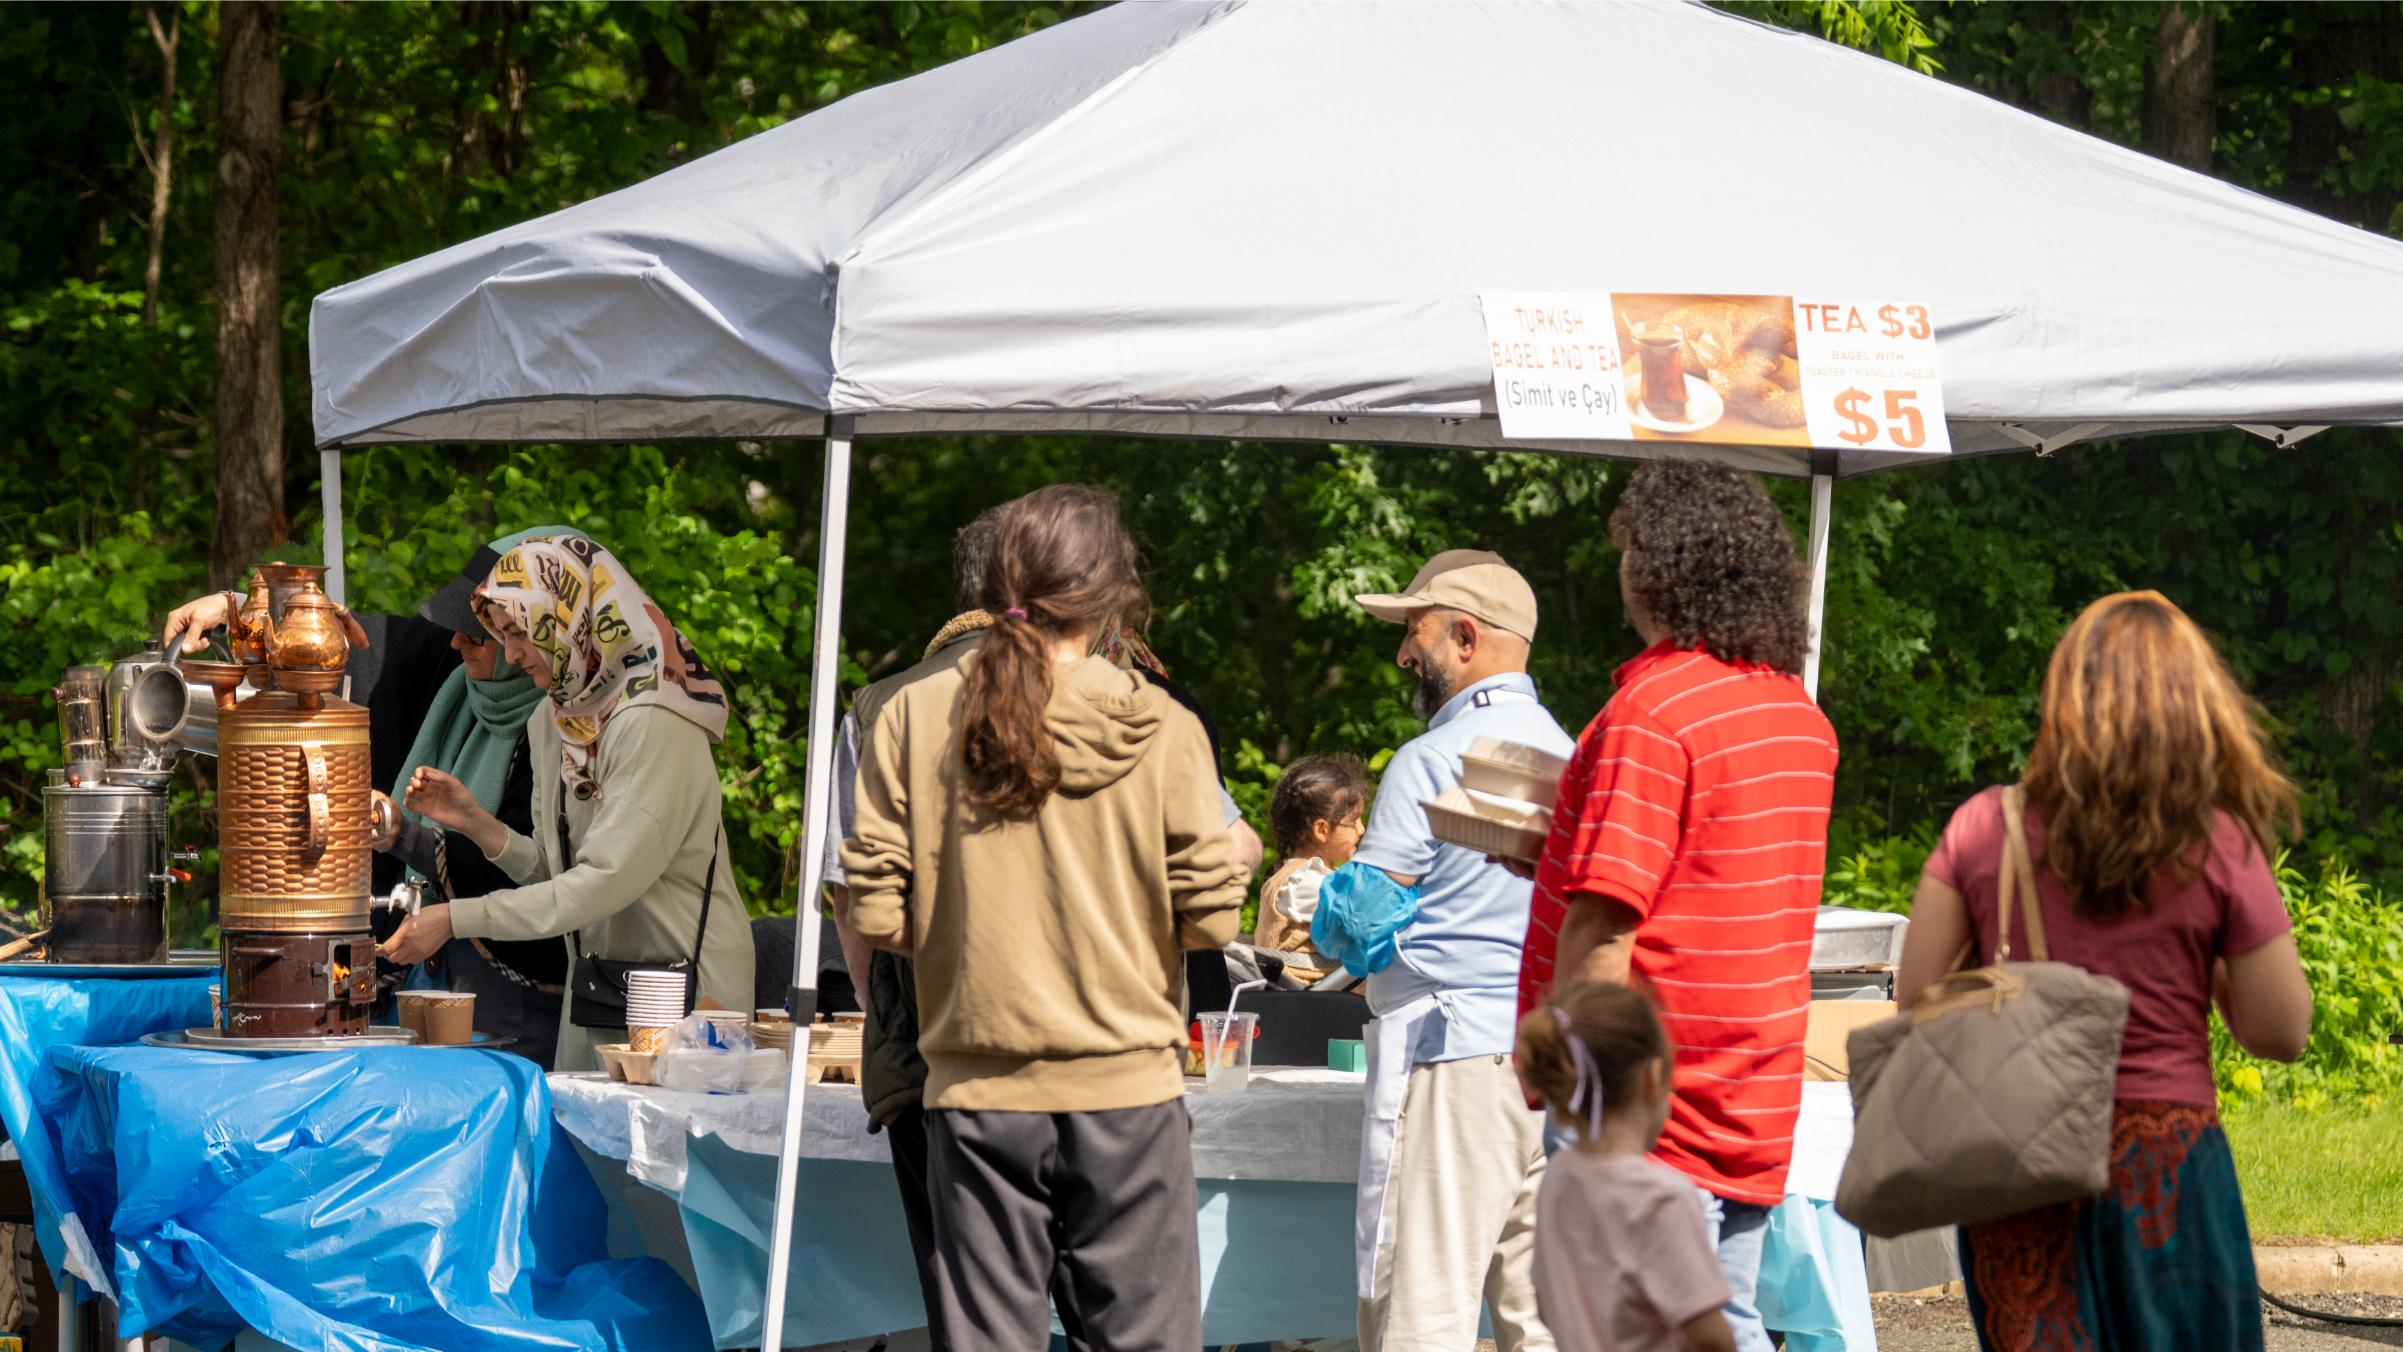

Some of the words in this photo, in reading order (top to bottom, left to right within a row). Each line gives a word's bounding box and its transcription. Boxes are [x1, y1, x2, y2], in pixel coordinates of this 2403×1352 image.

[1515, 308, 1584, 334] TURKISH
[1798, 303, 1868, 333] TEA
[1877, 303, 1931, 340] $3
[1492, 342, 1544, 369] BAGEL
[1551, 344, 1583, 370] AND
[1587, 345, 1619, 372] TEA
[1831, 350, 1871, 361] BAGEL
[1875, 351, 1905, 361] WITH
[1505, 379, 1554, 408] (Simit
[1558, 389, 1577, 408] ve
[1582, 383, 1617, 416] Çay)
[1833, 386, 1926, 449] $5
